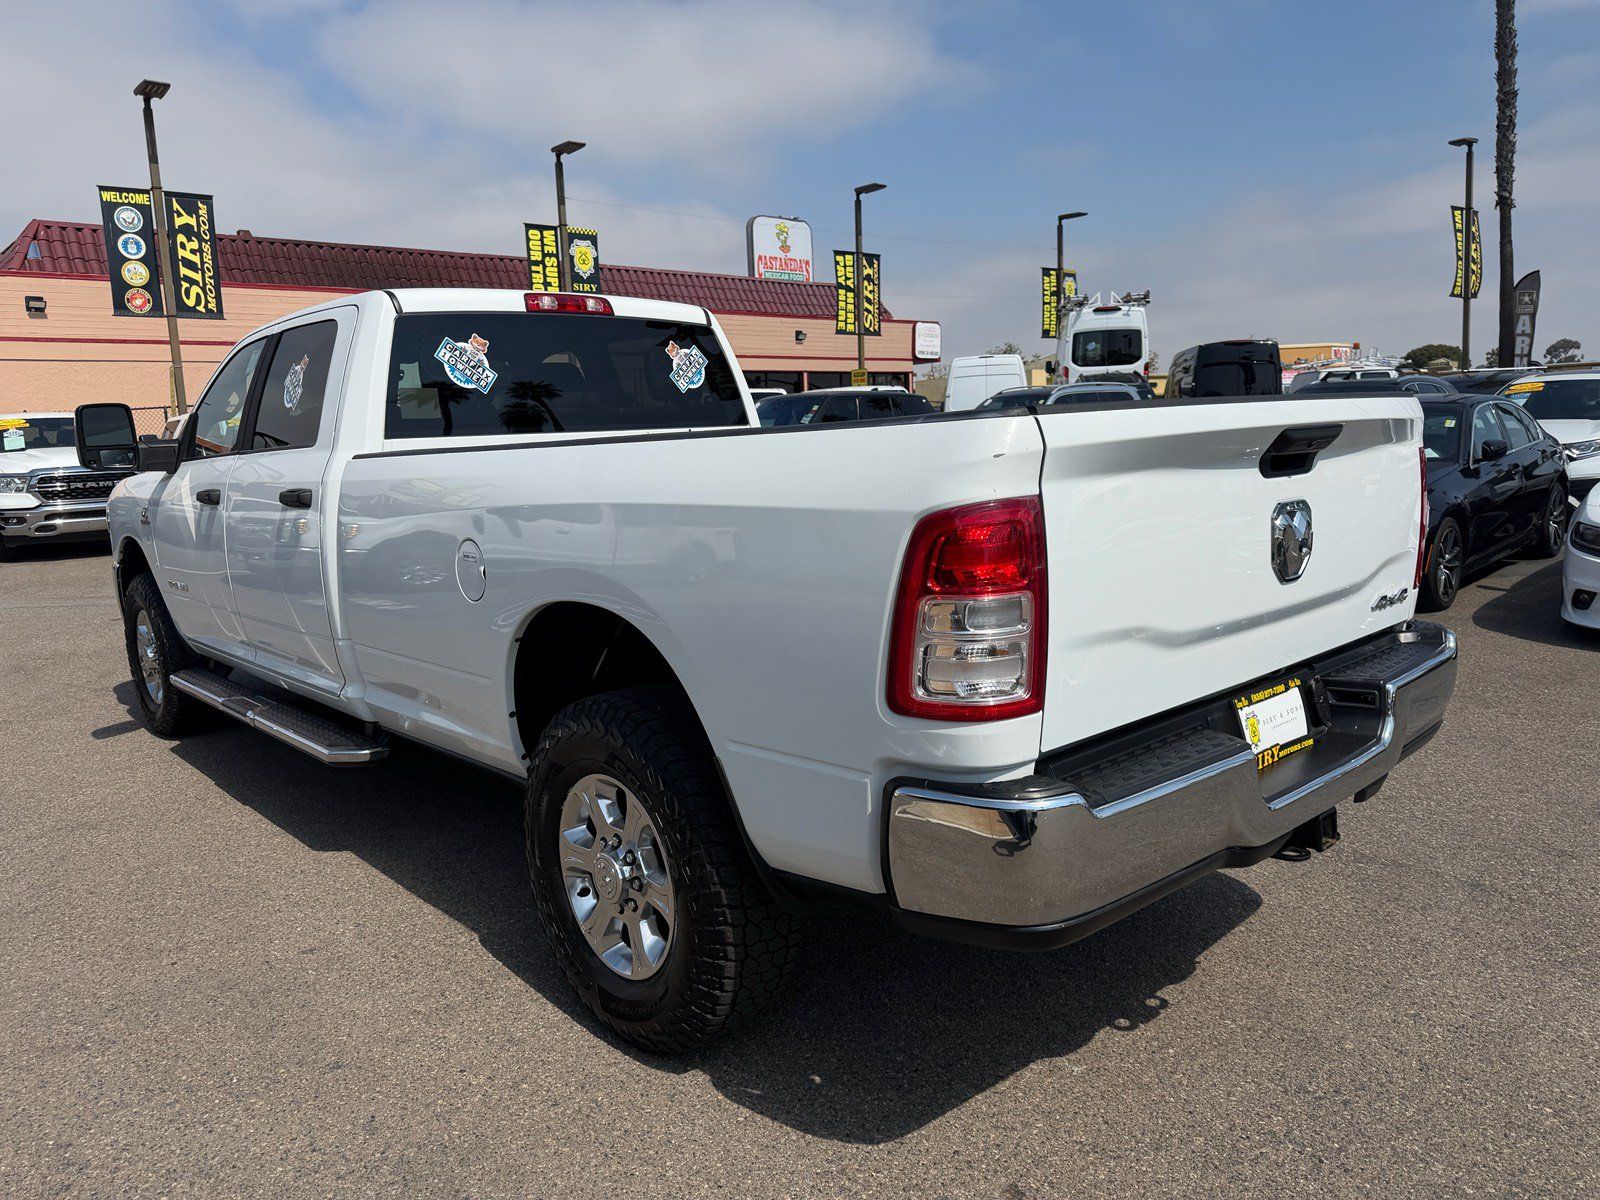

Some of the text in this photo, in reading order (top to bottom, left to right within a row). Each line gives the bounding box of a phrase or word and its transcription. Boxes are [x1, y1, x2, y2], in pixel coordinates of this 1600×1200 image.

[101, 190, 150, 205] WELCOME
[1454, 210, 1462, 230] WE
[172, 197, 206, 313] SIRY
[198, 201, 217, 313] MOTORS.COM
[528, 229, 542, 261] OUR
[543, 230, 557, 254] WE
[757, 255, 811, 282] CASTAÑEDA'S
[764, 271, 804, 281] MEXICAN FOOD
[573, 283, 598, 292] SIRY
[836, 255, 846, 330] PAY HERE
[845, 254, 855, 332] BUY HERE
[862, 256, 874, 332] SIRY
[445, 343, 491, 381] CARFAX
[448, 356, 488, 388] OWNER
[70, 480, 113, 489] RAM
